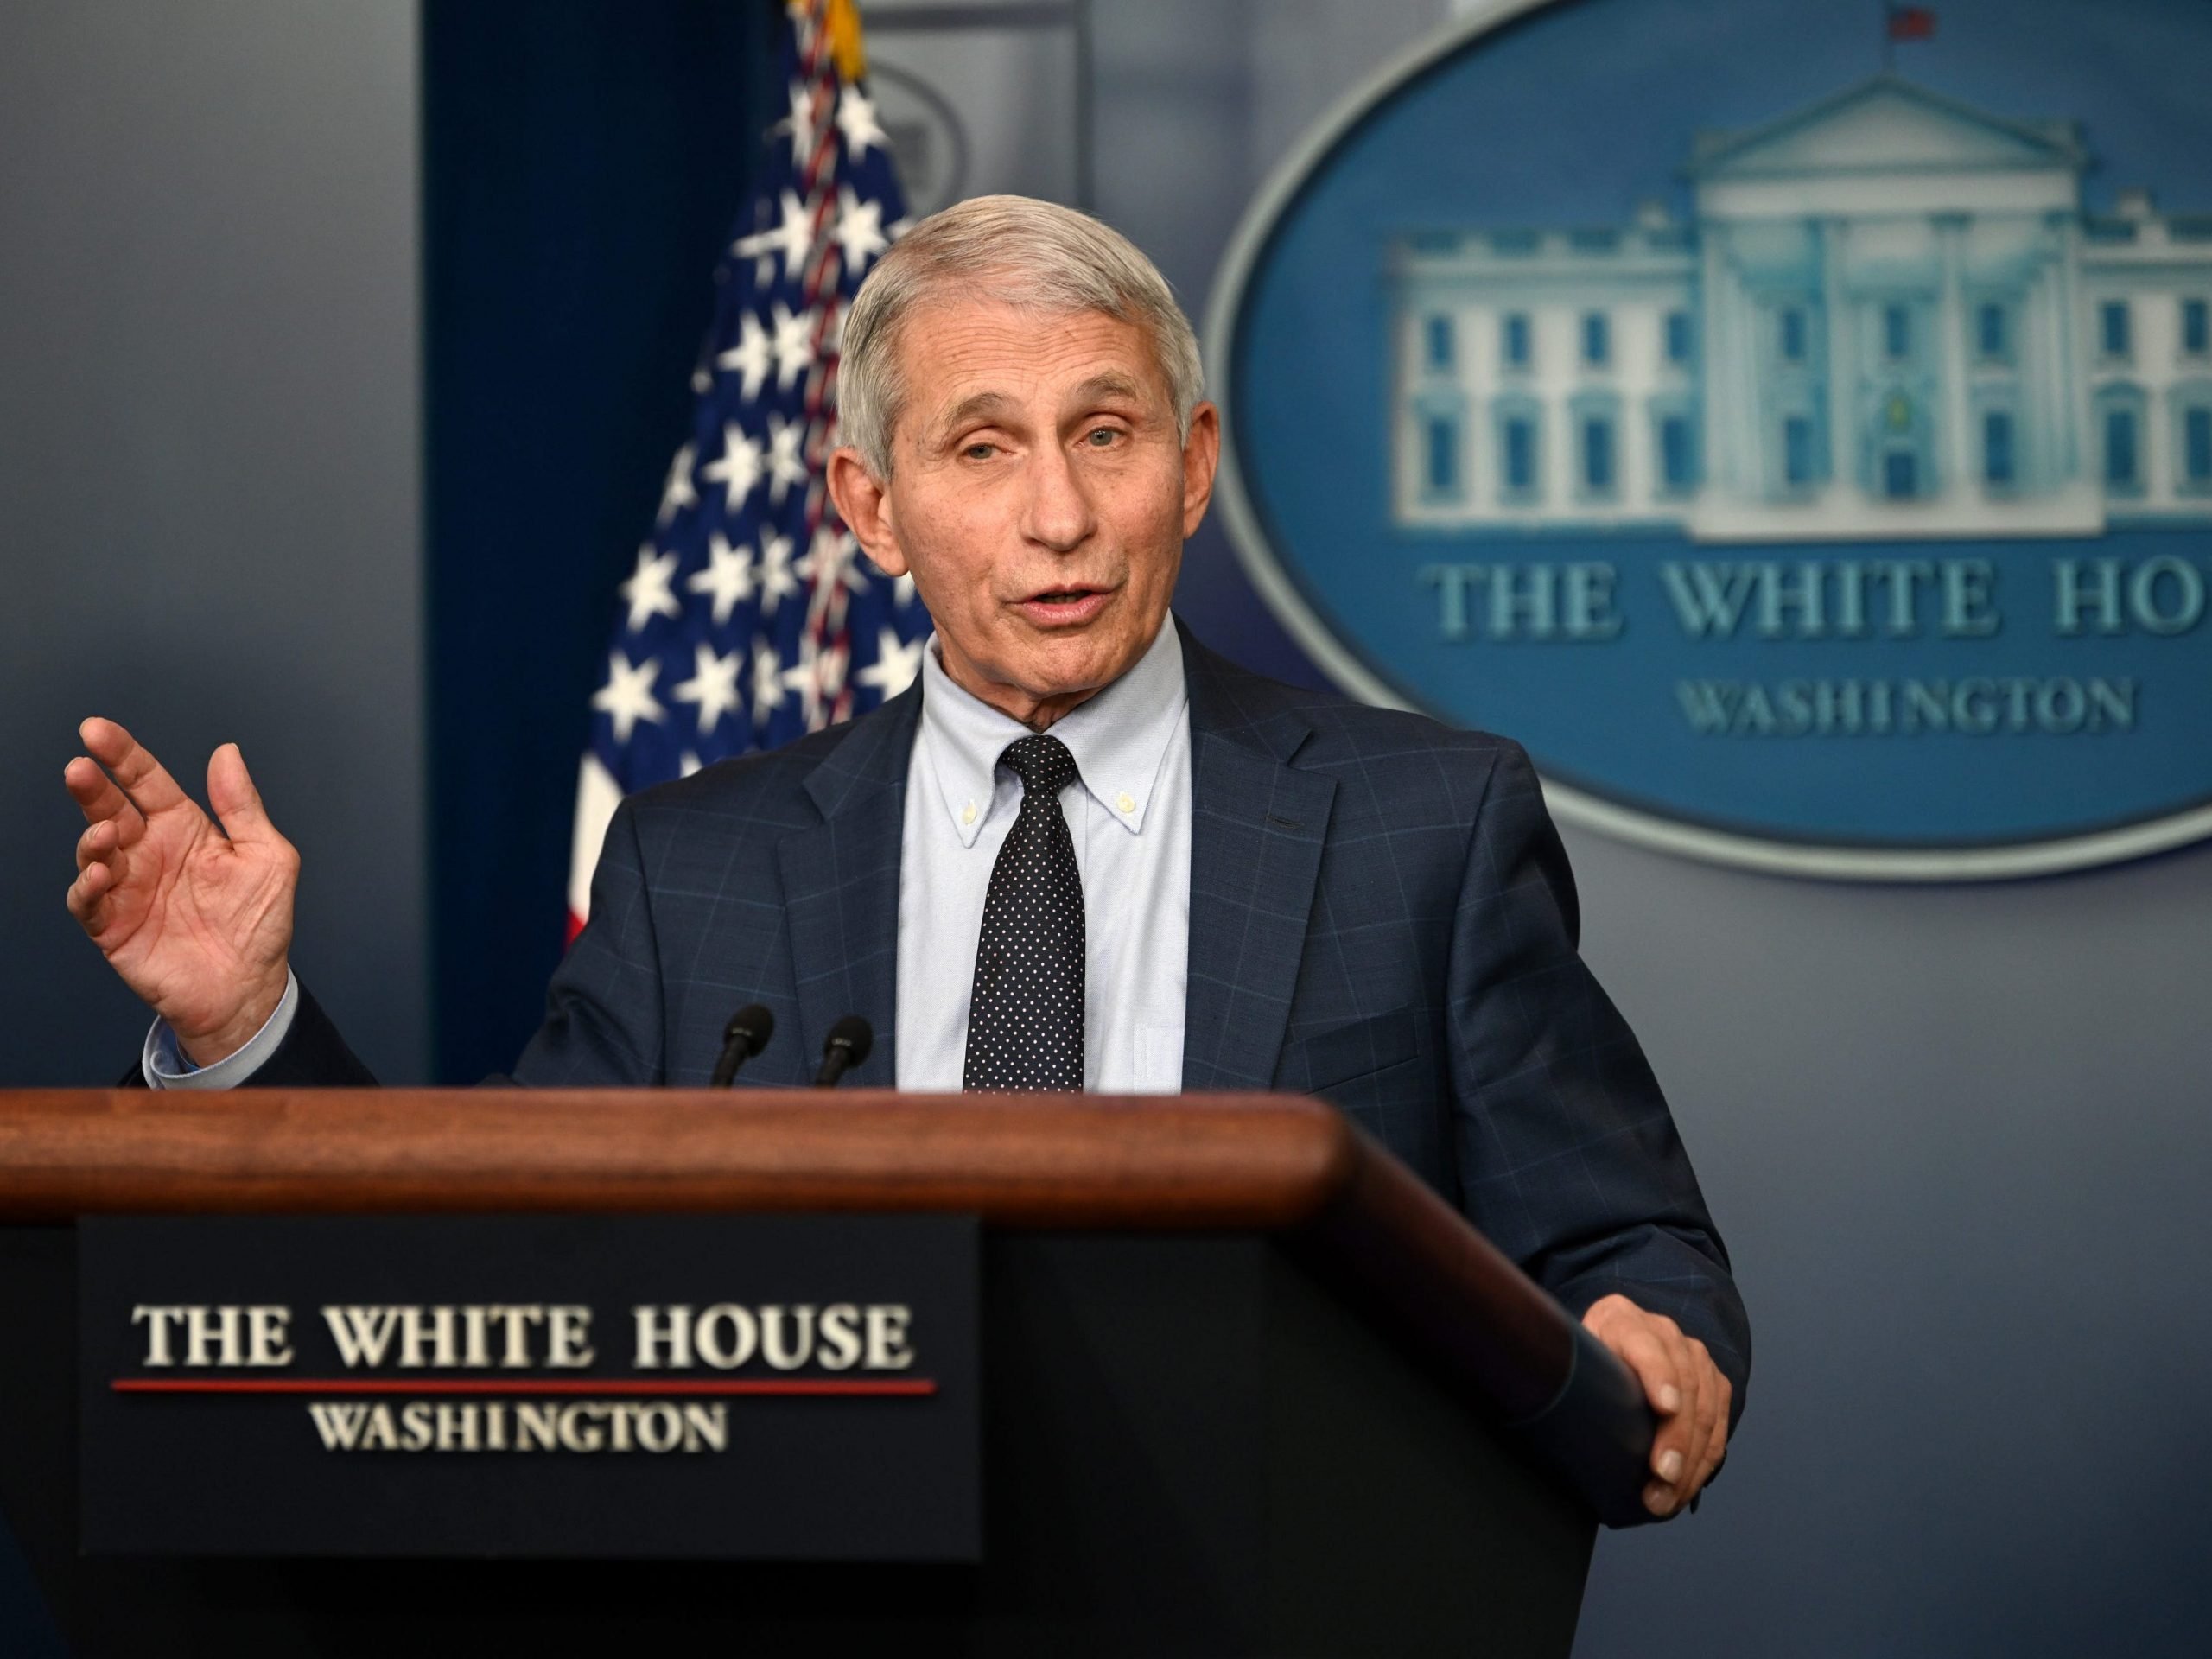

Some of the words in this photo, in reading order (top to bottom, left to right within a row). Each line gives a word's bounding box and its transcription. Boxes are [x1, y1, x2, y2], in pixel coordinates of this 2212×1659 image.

[1420, 562, 1624, 639] THE
[1661, 558, 1999, 638] WHITE
[2054, 554, 2205, 635] HO
[1679, 677, 2139, 734] WASHINGTON
[131, 1304, 294, 1368] THE
[321, 1304, 594, 1368] WHITE
[632, 1304, 914, 1370] HOUSE
[308, 1402, 728, 1452] WASHINGTON
